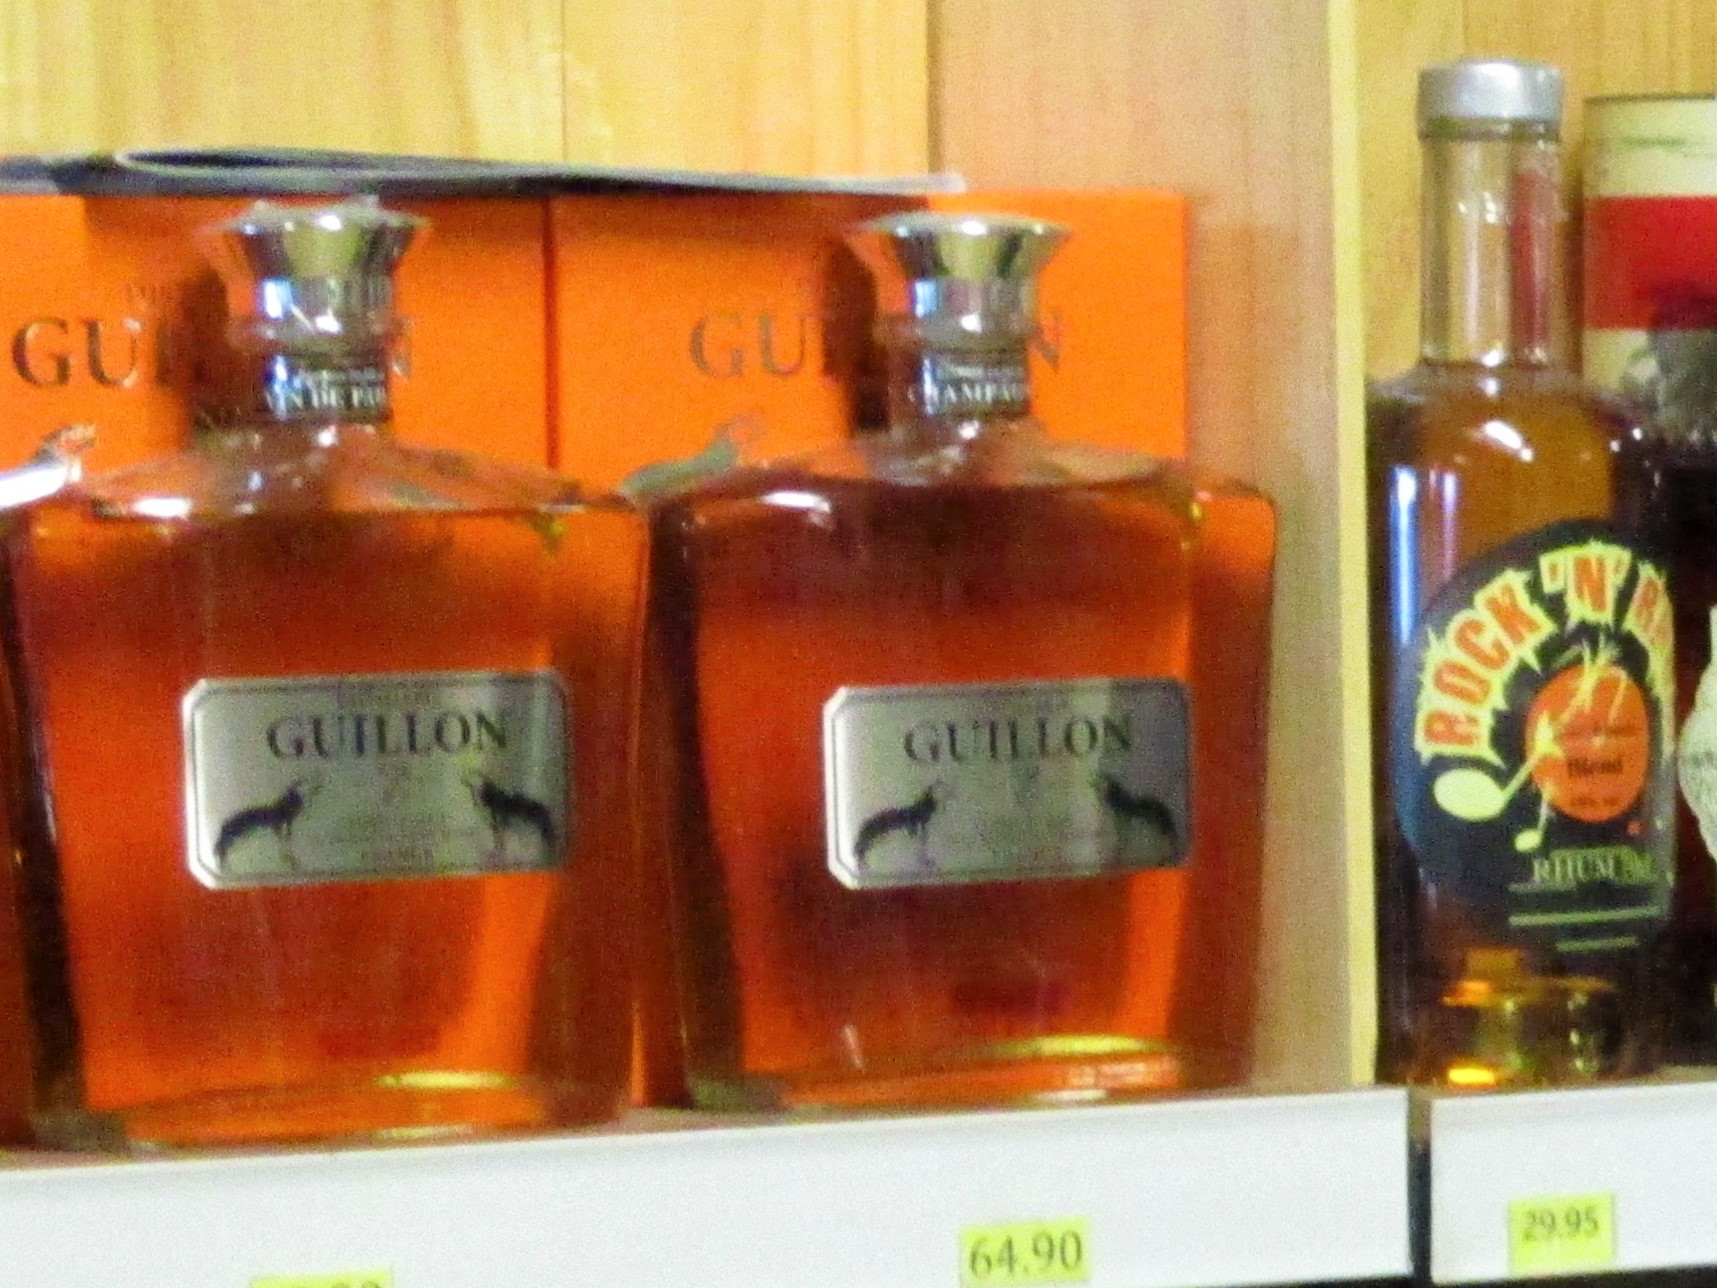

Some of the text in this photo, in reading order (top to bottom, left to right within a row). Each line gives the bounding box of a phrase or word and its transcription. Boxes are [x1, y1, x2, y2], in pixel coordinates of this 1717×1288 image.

[267, 710, 510, 760] GUILLON
[904, 711, 1134, 764] GUILLON
[1522, 1204, 1601, 1242] 29.95
[968, 1228, 1083, 1280] 64.90
